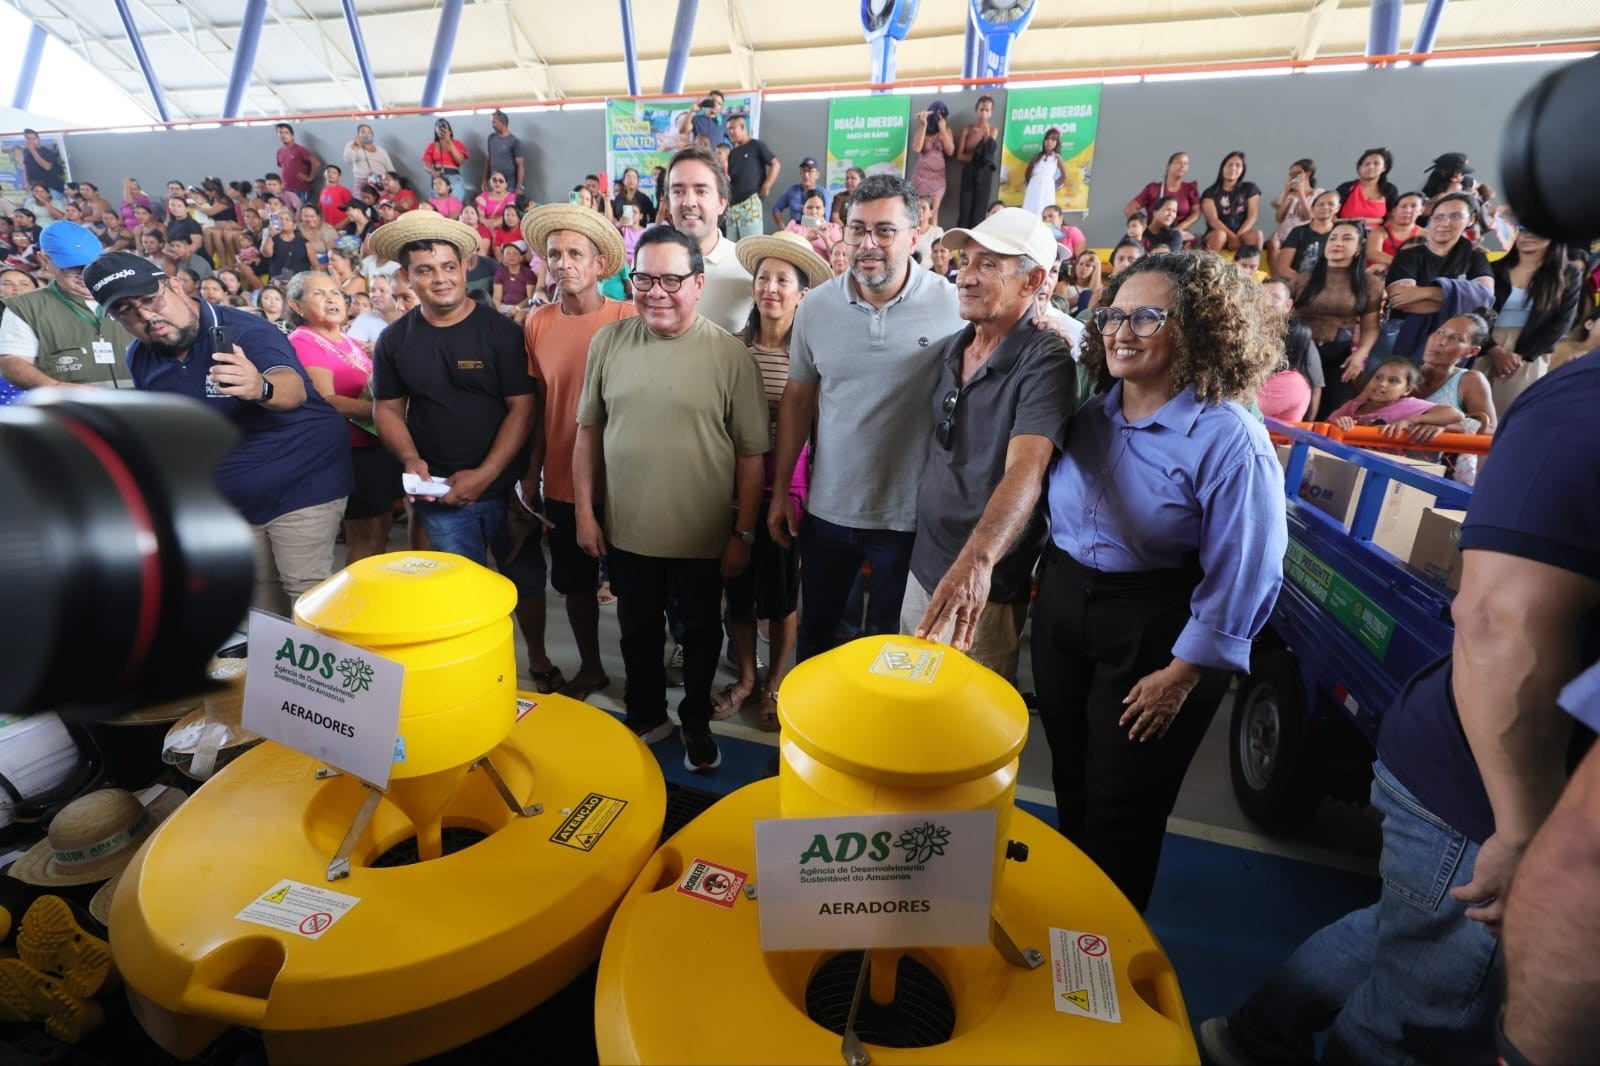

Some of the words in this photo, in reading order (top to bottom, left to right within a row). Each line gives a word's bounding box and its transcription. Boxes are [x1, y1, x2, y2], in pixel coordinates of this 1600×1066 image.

[834, 116, 865, 131] DOAÇÃO
[867, 115, 904, 128] ONEROSA
[1011, 106, 1048, 121] DOAÇÃO
[1050, 104, 1093, 118] ONEROSA
[1023, 122, 1078, 135] AERAOR
[93, 269, 136, 291] COMUNICAÇÃO
[275, 637, 336, 679] ADS
[274, 671, 306, 689] Sustentável
[307, 684, 315, 692] do
[316, 687, 345, 703] Amazonas
[275, 664, 298, 678] Agência
[299, 672, 306, 681] de
[307, 675, 355, 699] Desenvolvimento
[281, 700, 355, 738] AERADORES
[560, 797, 600, 840] ATENÇÃO
[799, 831, 892, 865] ADS
[800, 865, 835, 876] Agência
[837, 866, 848, 874] de
[850, 864, 925, 873] Desenvolvimento
[800, 874, 850, 884] Sustentável
[866, 873, 911, 881] Amazonas
[725, 876, 744, 902] PERIGO
[818, 900, 931, 916] AERADORES
